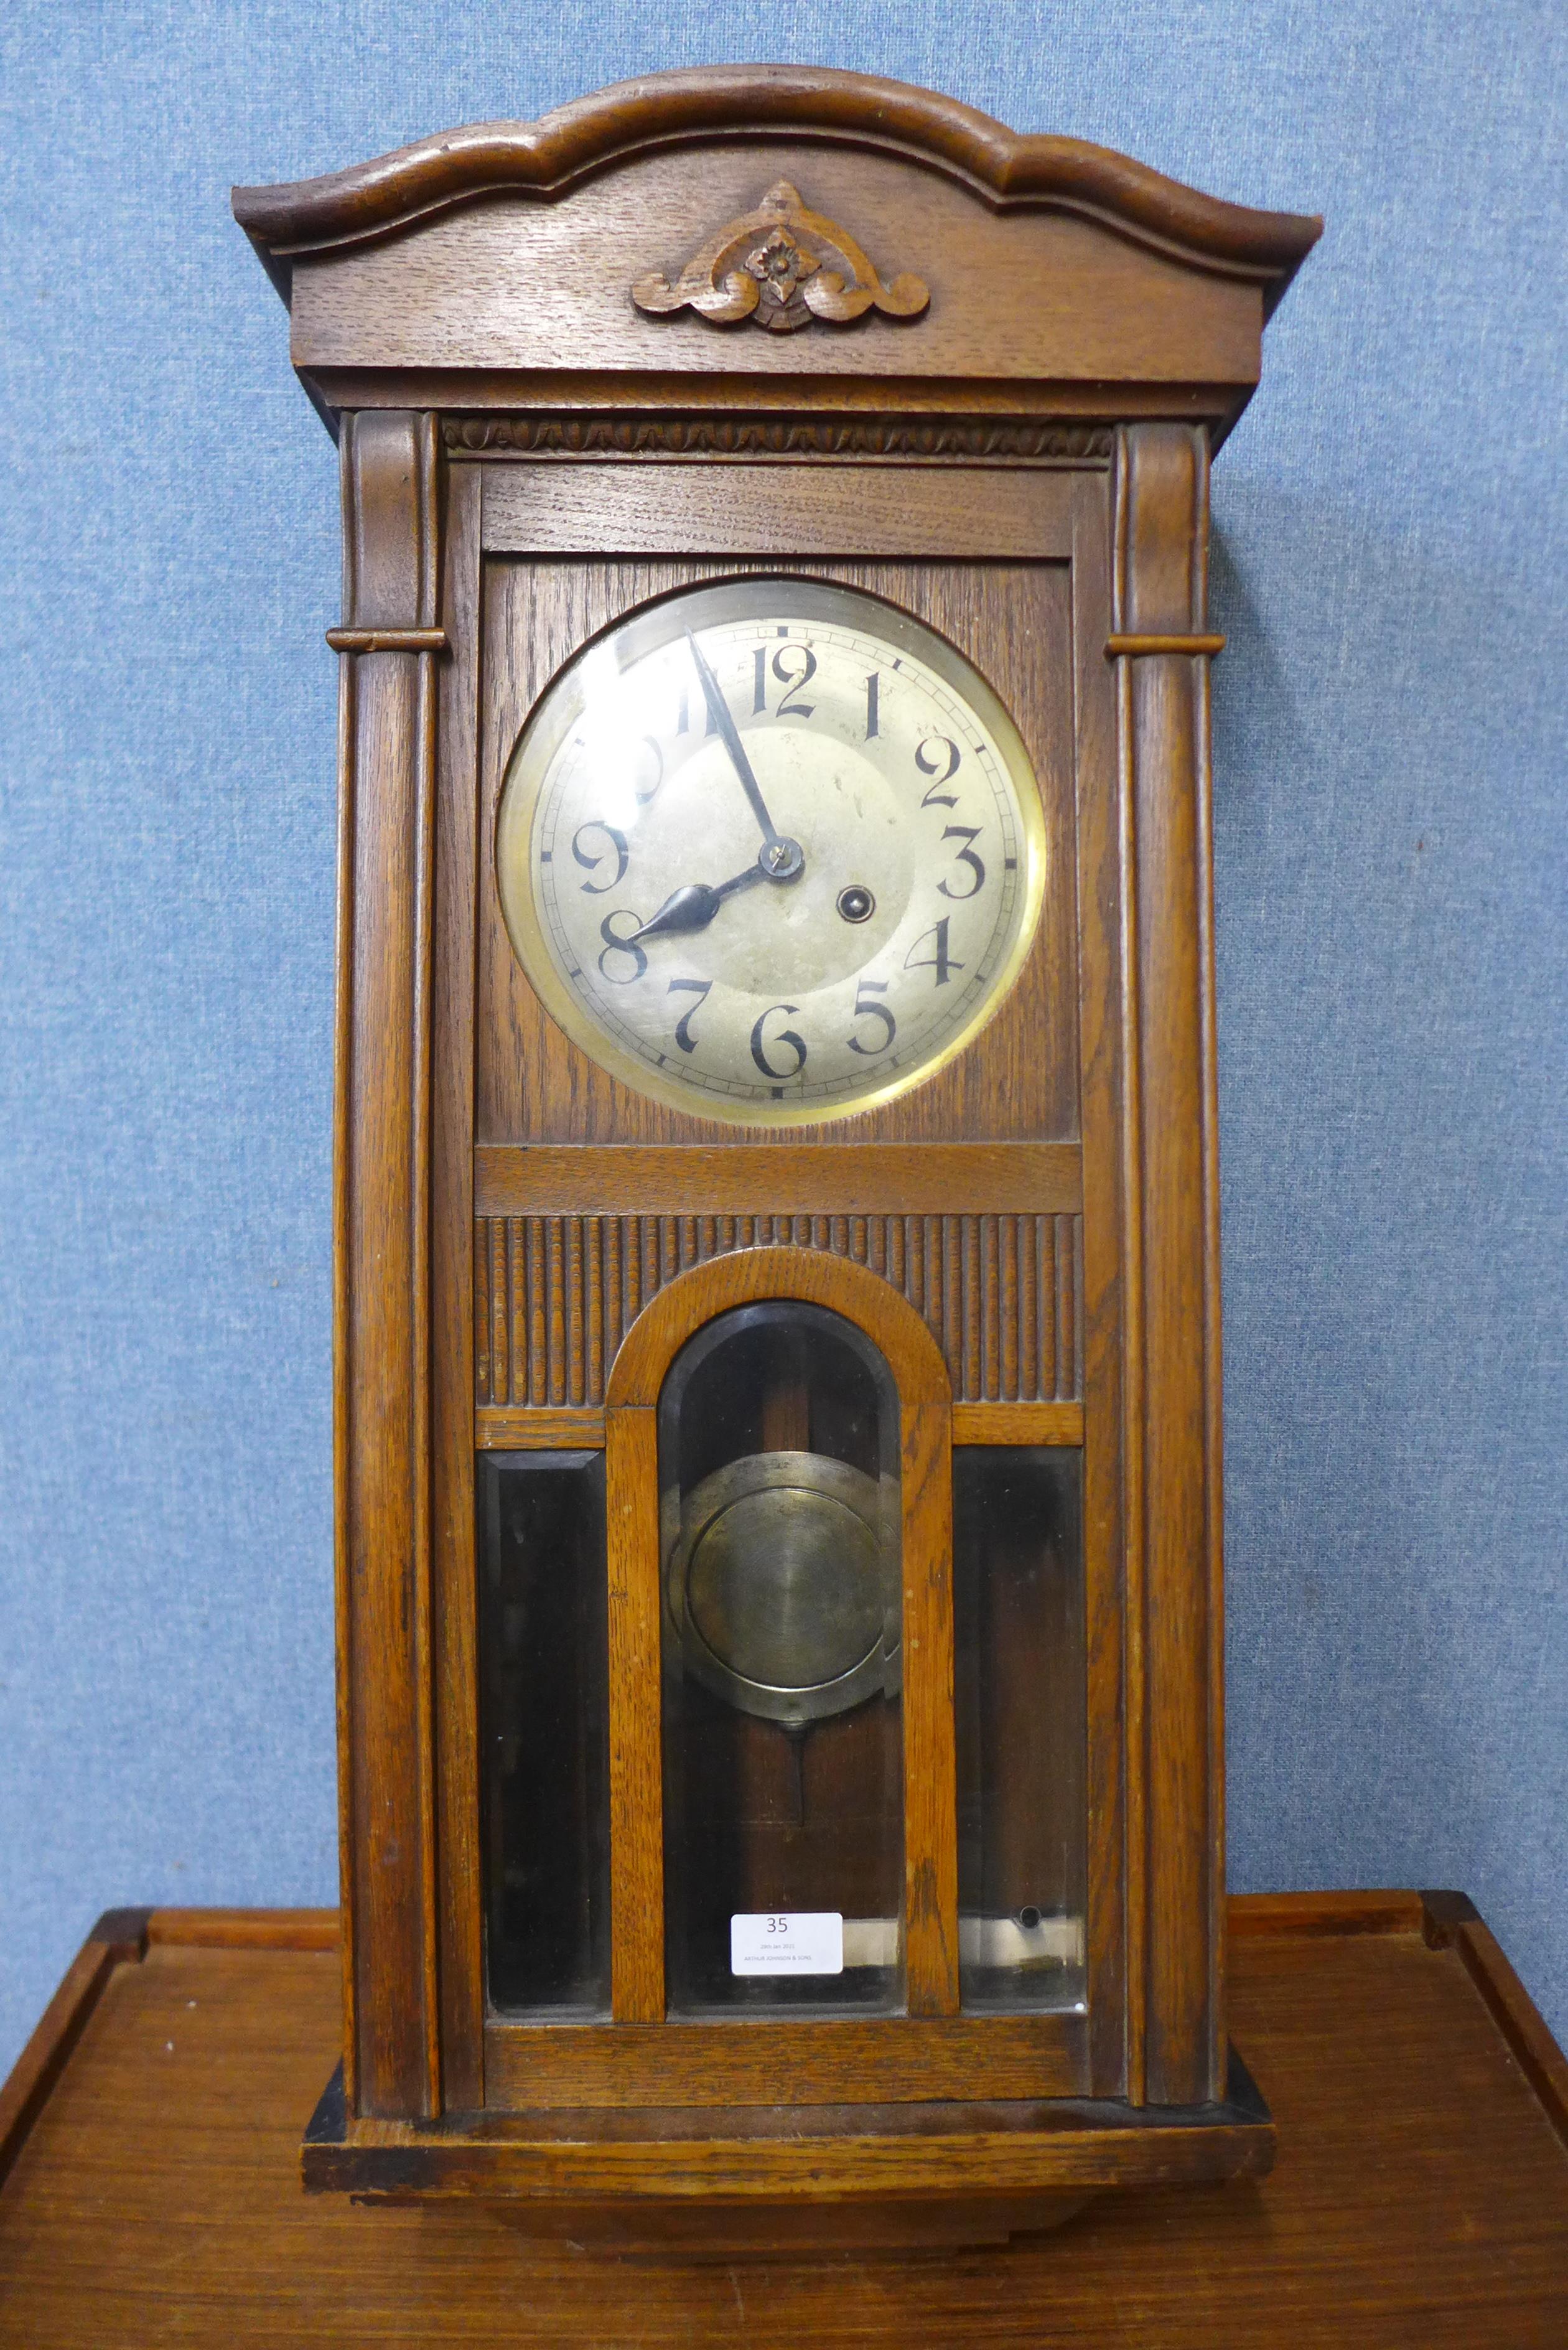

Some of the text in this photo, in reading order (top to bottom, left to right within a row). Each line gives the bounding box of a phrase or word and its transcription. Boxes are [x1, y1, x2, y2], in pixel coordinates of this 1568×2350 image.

[750, 644, 817, 719] 12
[864, 671, 879, 742] 1
[914, 734, 961, 808] 2
[571, 820, 629, 895] 9
[937, 825, 986, 900] 3
[597, 909, 649, 985] 8
[903, 915, 966, 988] 4
[666, 977, 714, 1054] 7
[750, 1004, 808, 1080] 6
[846, 978, 897, 1056] 5
[767, 1917, 788, 1933] 35
